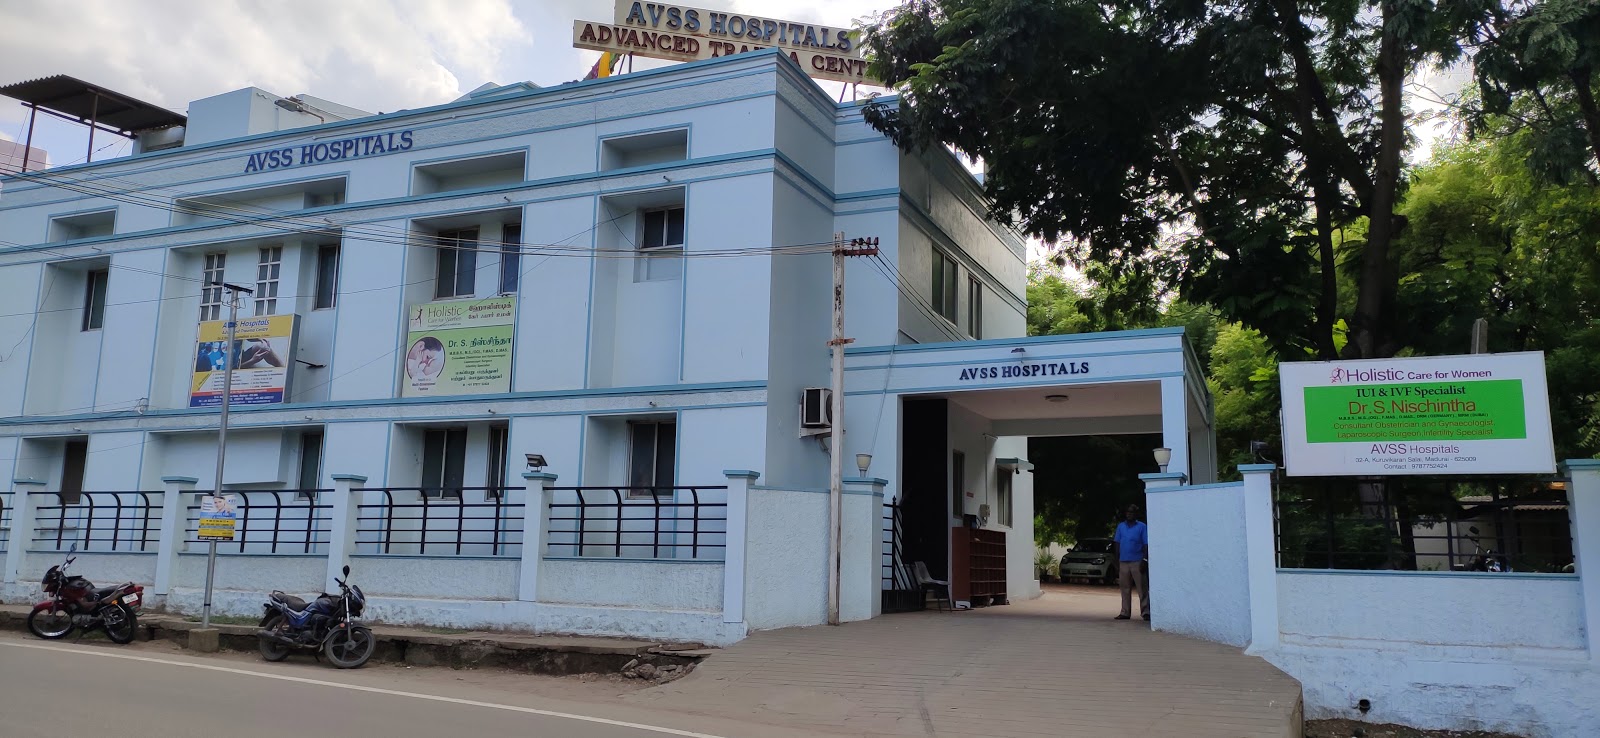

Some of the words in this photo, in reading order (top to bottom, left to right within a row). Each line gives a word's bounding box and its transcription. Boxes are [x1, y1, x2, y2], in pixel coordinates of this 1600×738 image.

[625, 1, 701, 32] AVSS
[708, 12, 854, 51] HOSPITALS
[580, 23, 700, 57] ADVANCED
[244, 148, 293, 172] AVSS
[300, 130, 413, 164] HOSPITALS
[428, 306, 462, 318] Holistic
[240, 319, 270, 328] Hospitals
[959, 366, 998, 380] AVSS
[1002, 362, 1089, 378] HOSPITALS
[1346, 368, 1404, 382] Holistic
[1408, 372, 1432, 380] Care
[1435, 370, 1448, 378] for
[1451, 370, 1492, 378] Women
[1356, 388, 1375, 397] IUI
[1378, 388, 1388, 397] &
[1390, 387, 1412, 397] IVF
[1414, 385, 1466, 398] Specialist
[1456, 428, 1494, 437] Specialist
[1371, 444, 1407, 454] AVSS
[1410, 445, 1460, 455] Hospitals
